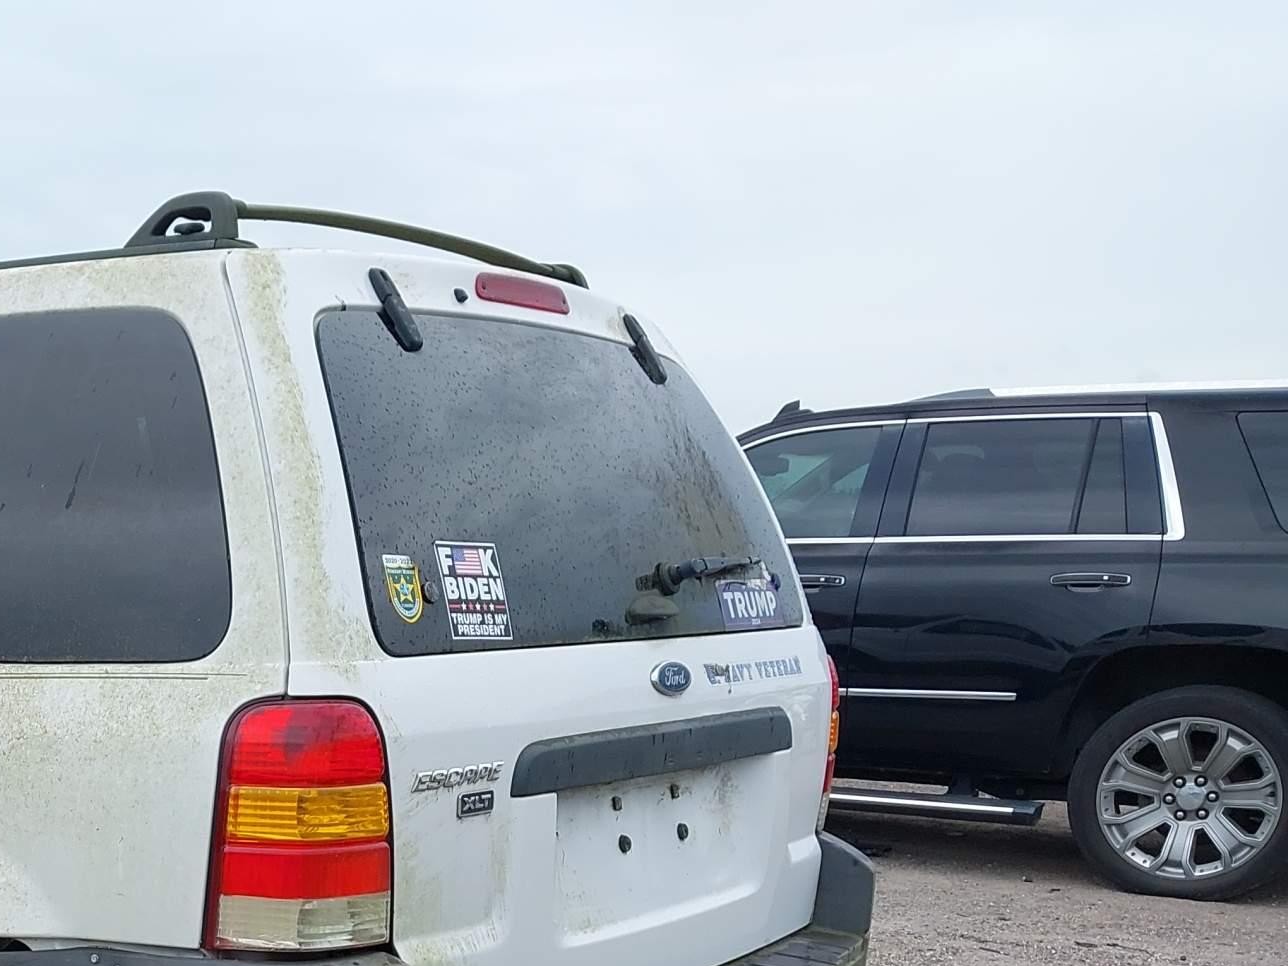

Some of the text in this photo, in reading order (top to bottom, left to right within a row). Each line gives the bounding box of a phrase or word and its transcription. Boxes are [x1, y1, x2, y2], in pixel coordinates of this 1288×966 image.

[444, 576, 505, 601] BIDEN
[722, 591, 777, 619] TRUMP
[451, 612, 508, 625] TRUMP IS MY
[457, 624, 506, 636] PRESIDENT
[664, 666, 686, 686] Ford
[411, 761, 505, 793] ESCAPE
[462, 793, 492, 812] XLT
